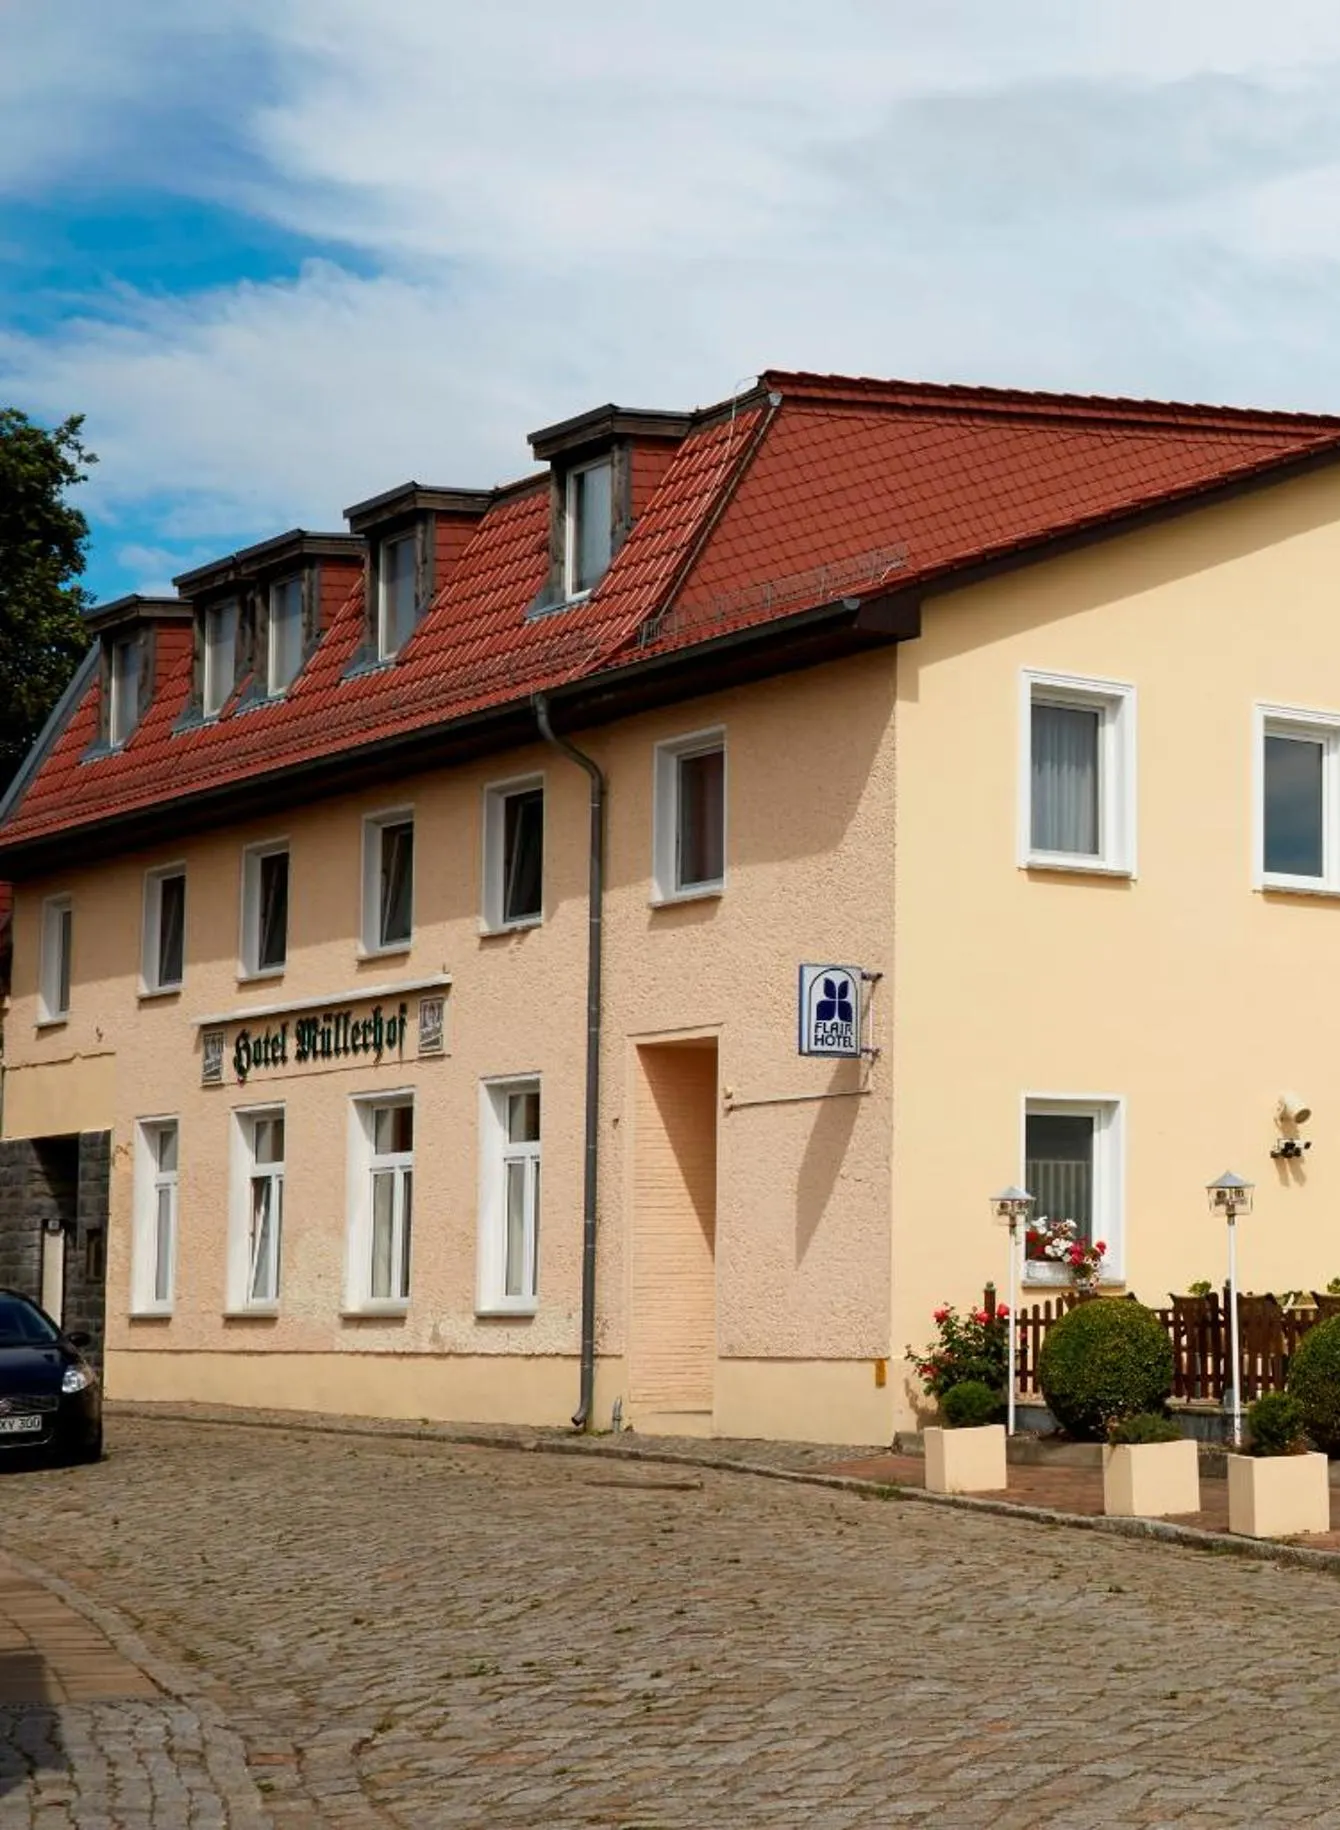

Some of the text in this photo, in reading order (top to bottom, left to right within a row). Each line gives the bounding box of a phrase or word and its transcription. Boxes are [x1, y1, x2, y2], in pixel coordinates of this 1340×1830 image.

[815, 1022, 853, 1036] FLAIR
[233, 1003, 408, 1087] Hotel Müllerhof
[814, 1034, 853, 1048] HOTEL
